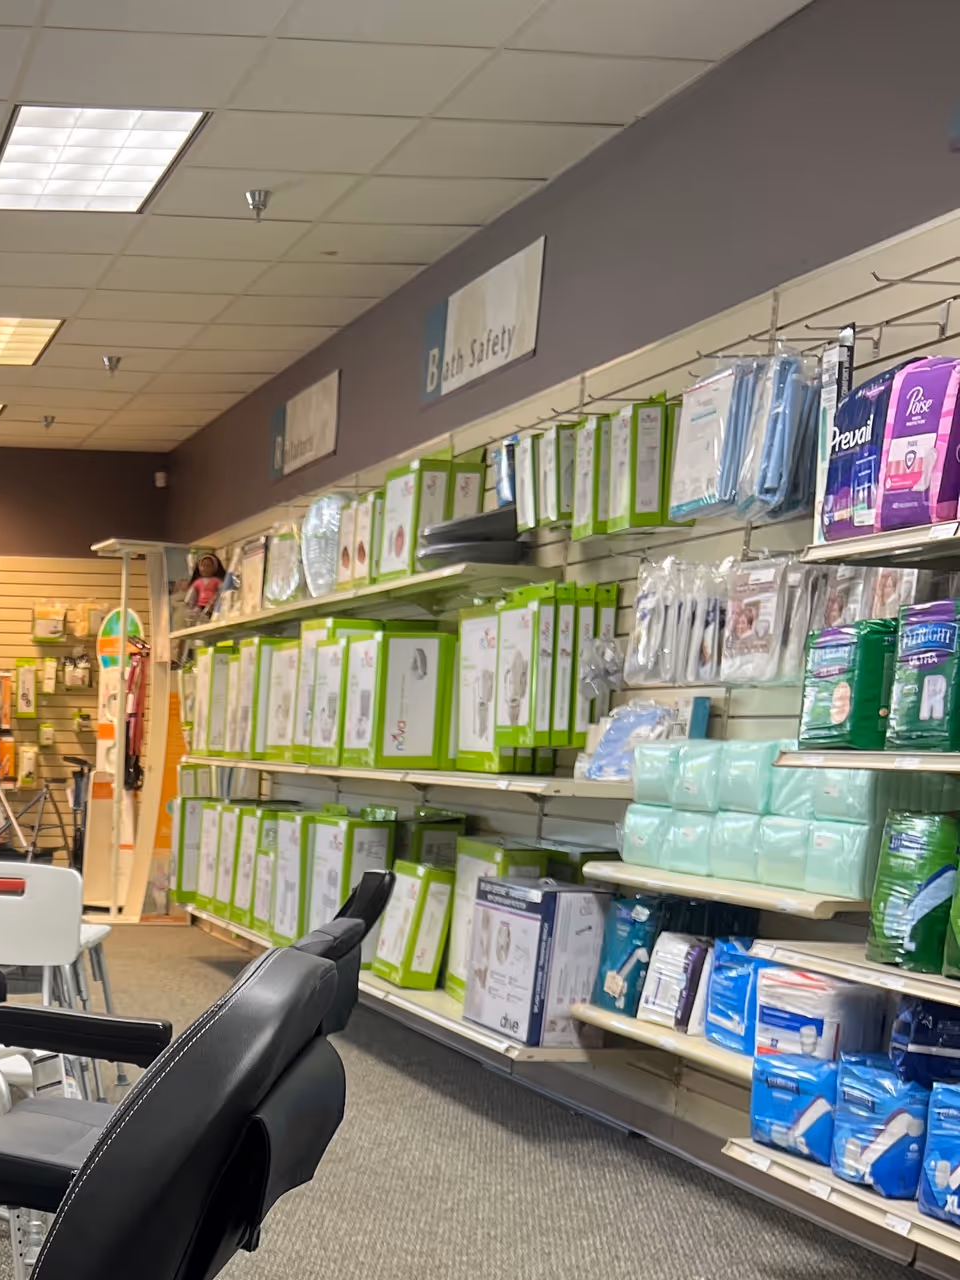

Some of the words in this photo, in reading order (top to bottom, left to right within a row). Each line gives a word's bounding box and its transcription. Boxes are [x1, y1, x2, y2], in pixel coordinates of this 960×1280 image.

[426, 347, 464, 393] Bath
[469, 323, 517, 369] Safety
[906, 385, 933, 417] Poise
[830, 413, 874, 452] Prevail
